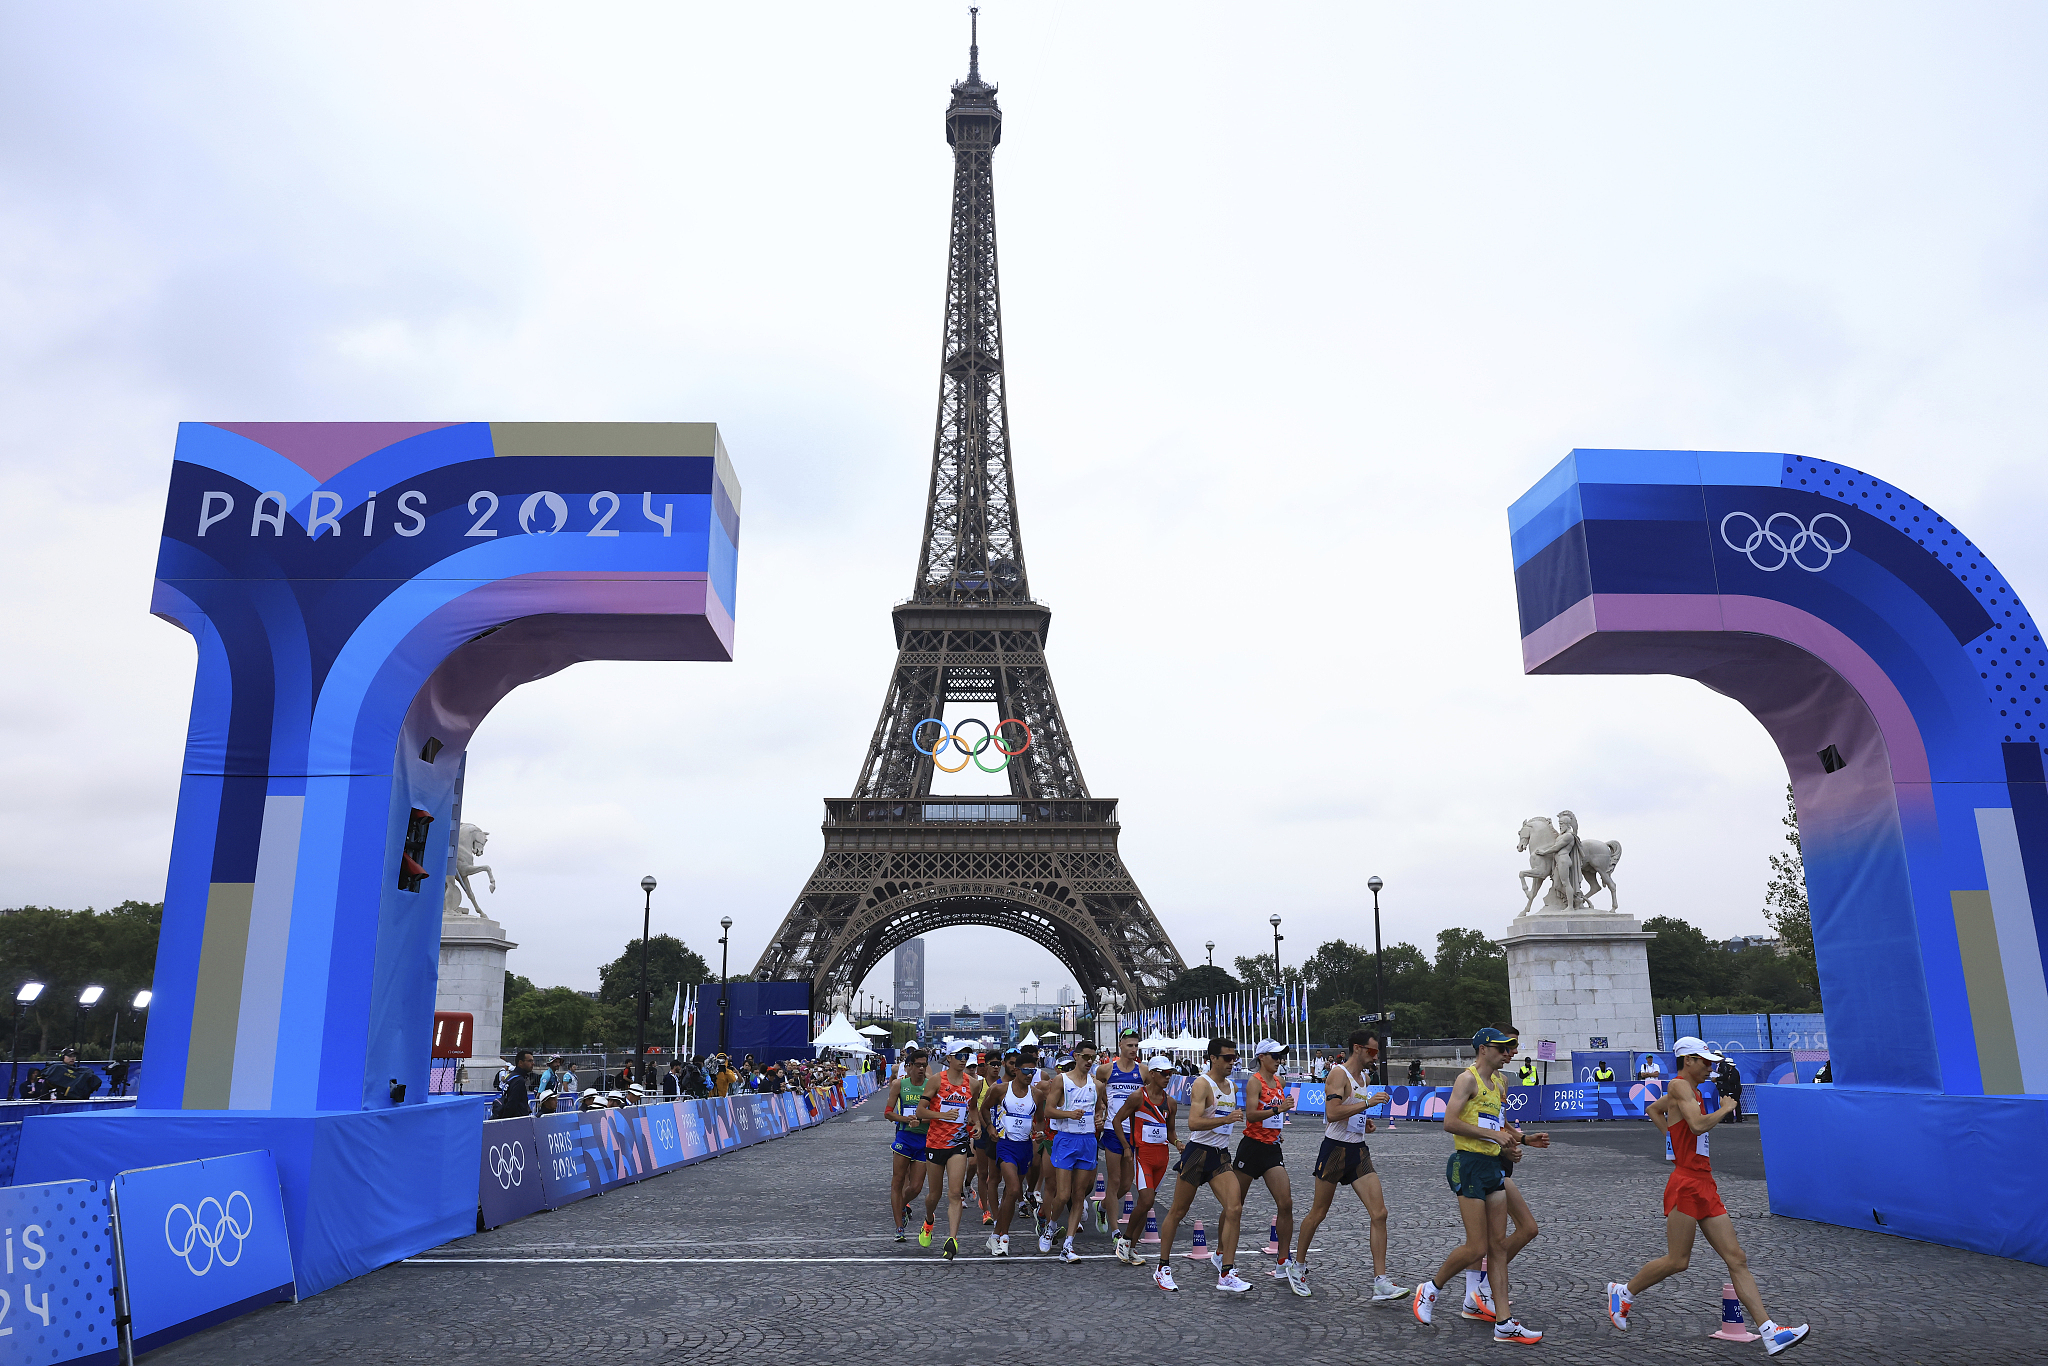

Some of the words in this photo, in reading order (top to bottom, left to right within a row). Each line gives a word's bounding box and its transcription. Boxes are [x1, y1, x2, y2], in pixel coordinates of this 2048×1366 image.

[464, 490, 673, 538] 2024
[435, 1020, 465, 1047] 11
[944, 1094, 967, 1102] JAPAN
[1554, 1100, 1584, 1111] 2024
[1014, 1118, 1023, 1126] 29
[552, 1156, 578, 1181] 2024
